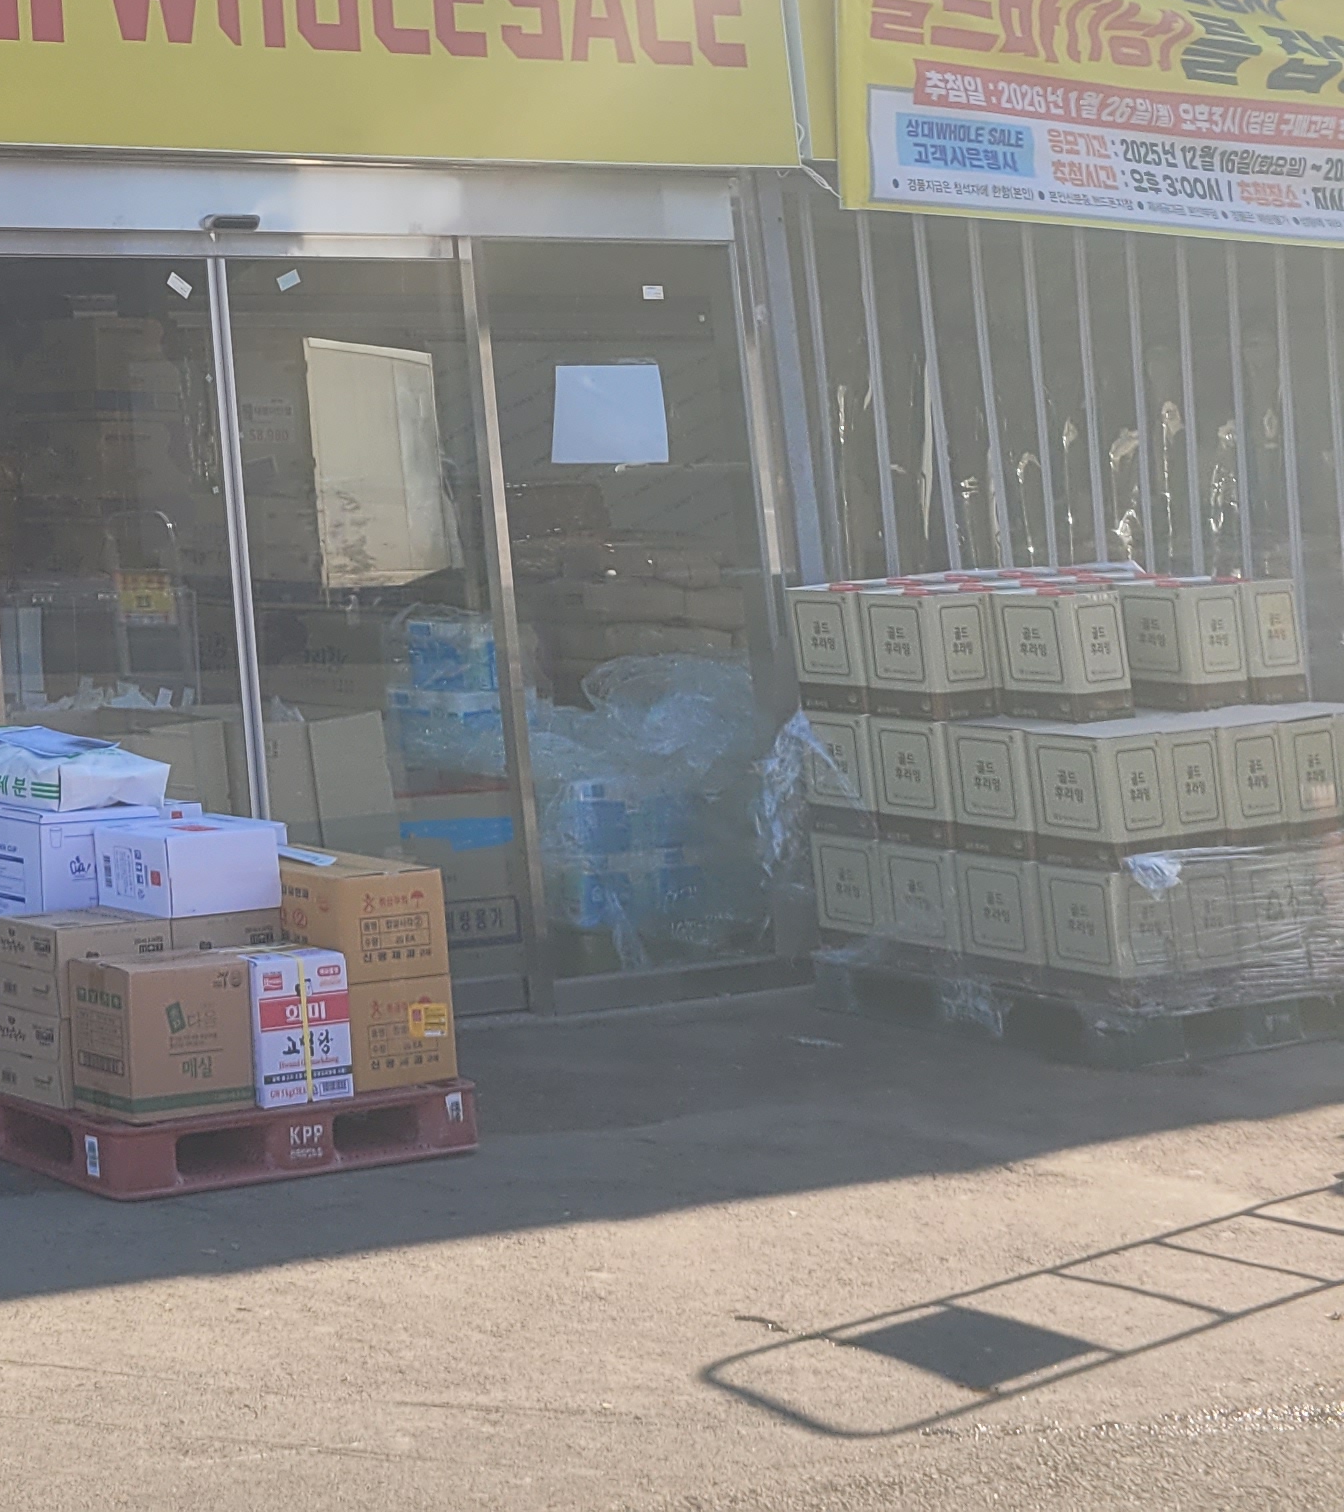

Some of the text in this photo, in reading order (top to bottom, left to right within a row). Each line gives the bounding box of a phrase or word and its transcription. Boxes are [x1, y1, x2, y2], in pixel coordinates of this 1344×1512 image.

[925, 70, 987, 106] 추첨일
[998, 80, 1065, 116] 2026년
[1068, 90, 1104, 120] 1월
[988, 126, 1025, 149] SALE
[1047, 127, 1112, 159] 응모기간
[1120, 138, 1179, 169] 2025년
[1180, 144, 1218, 172] 12월
[912, 142, 1019, 173] 고객사은행사
[1051, 159, 1119, 191] 추첨시간
[1130, 168, 1163, 196] 오후
[290, 1124, 324, 1146] KPP
